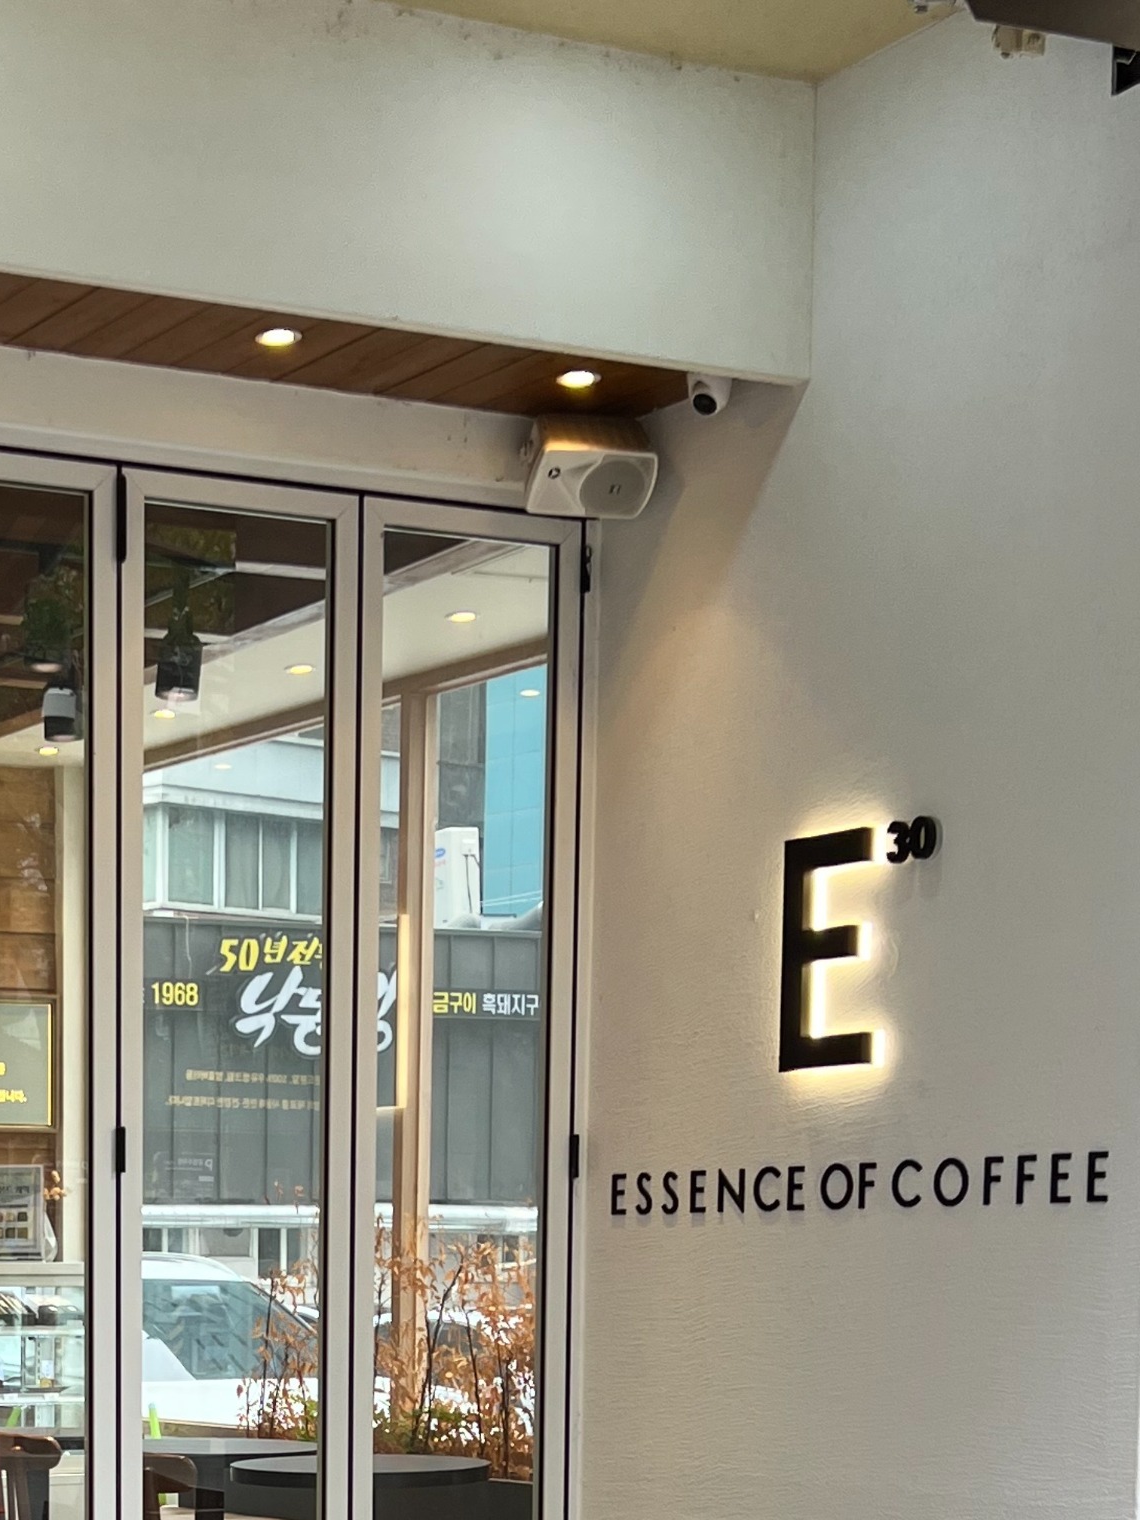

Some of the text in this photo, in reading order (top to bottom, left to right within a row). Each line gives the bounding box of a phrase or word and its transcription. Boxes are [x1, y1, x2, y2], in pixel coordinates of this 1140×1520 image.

[220, 935, 322, 972] 50년전
[779, 816, 938, 1072] E 30
[151, 981, 199, 1006] 1968
[610, 1150, 1110, 1216] ESSENCE OF COFFEE
